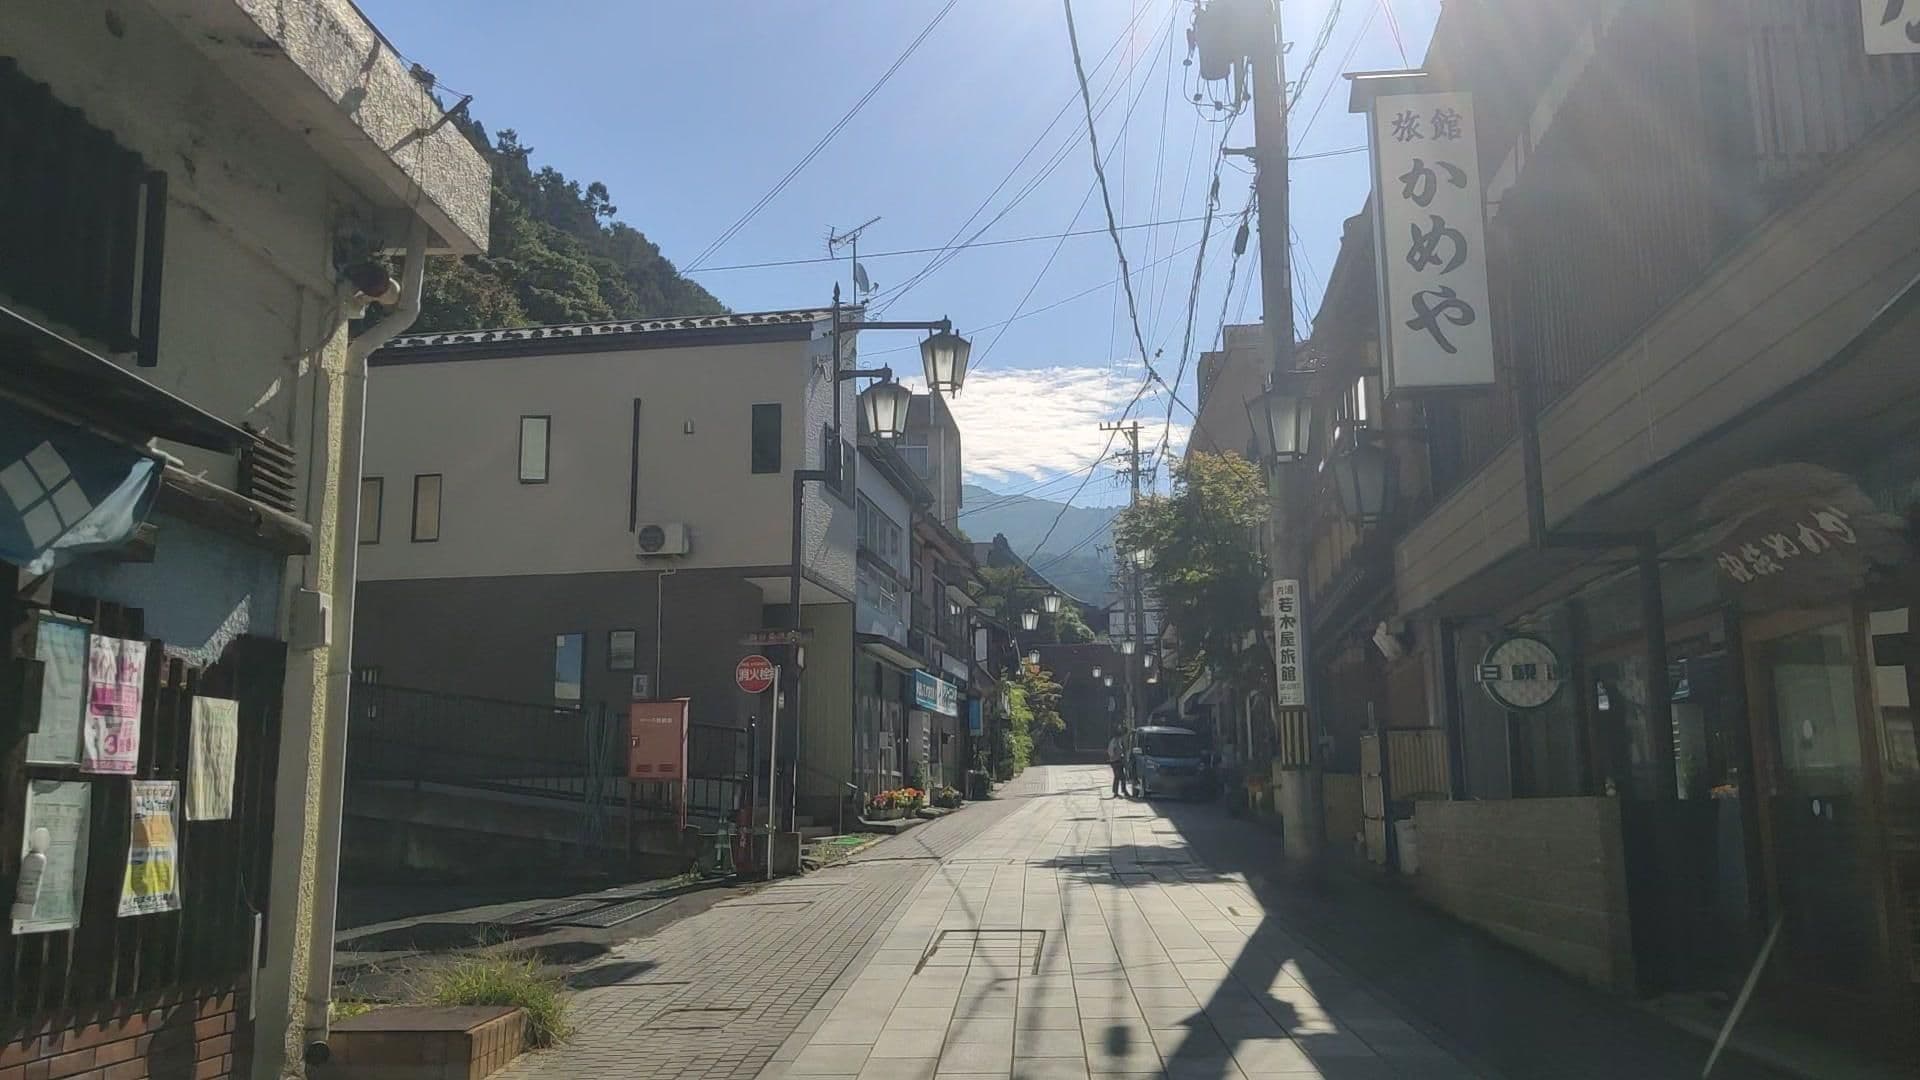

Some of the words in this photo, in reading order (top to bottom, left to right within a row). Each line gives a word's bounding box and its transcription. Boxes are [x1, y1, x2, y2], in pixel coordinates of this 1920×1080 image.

[1391, 108, 1463, 143] 旅館
[1398, 157, 1477, 355] かめや
[738, 667, 771, 681] 消火栓
